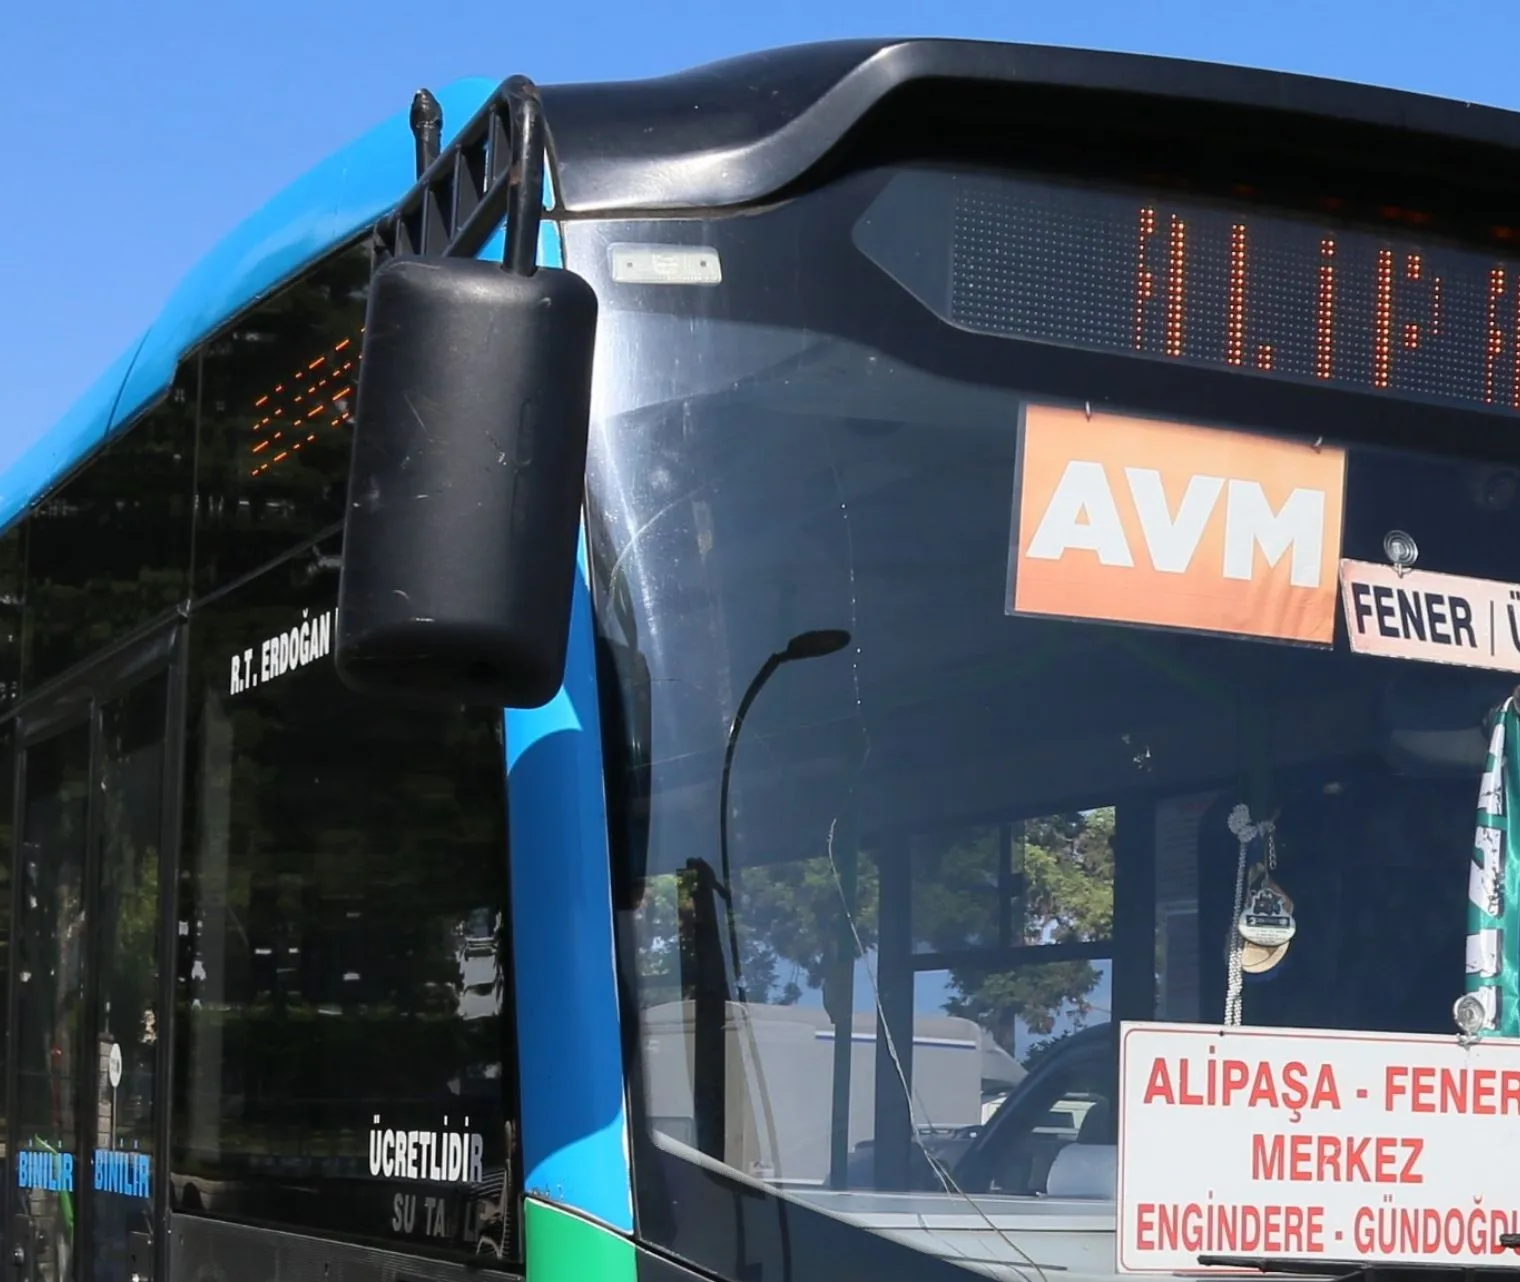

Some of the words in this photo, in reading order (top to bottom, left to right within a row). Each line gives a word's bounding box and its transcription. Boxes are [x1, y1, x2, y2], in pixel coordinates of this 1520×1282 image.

[1026, 460, 1325, 589] AVM
[1351, 582, 1477, 649] FENER
[230, 648, 258, 695] R.T.
[261, 607, 330, 683] ERDOĞAN
[1143, 1045, 1341, 1123] ALİPAŞA
[369, 1114, 483, 1183] ÜCRETLİDİR
[1251, 1133, 1425, 1184] MERKEZ
[392, 1193, 416, 1234] SU
[1136, 1191, 1325, 1252] ENGİNDERE
